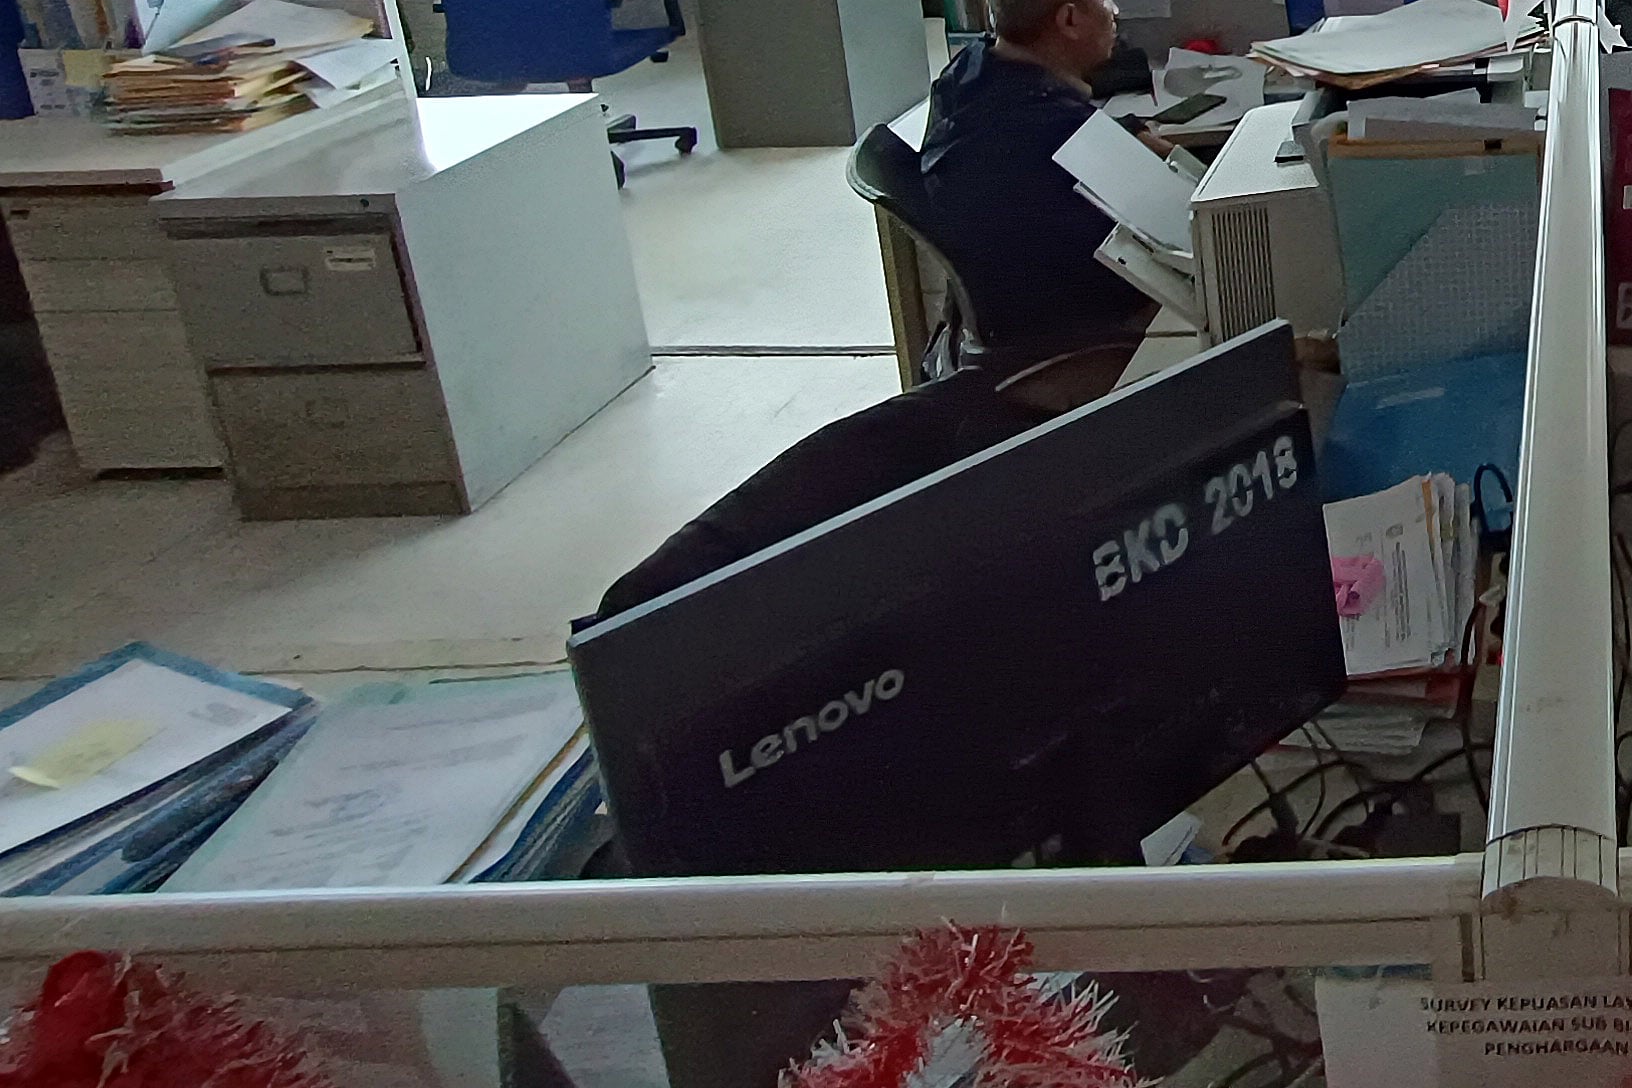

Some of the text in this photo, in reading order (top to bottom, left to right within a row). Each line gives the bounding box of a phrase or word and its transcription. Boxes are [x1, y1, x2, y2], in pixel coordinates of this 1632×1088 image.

[1092, 503, 1190, 602] BKD
[718, 668, 906, 789] Lenovo
[1420, 996, 1491, 1013] SURVEY
[1496, 995, 1598, 1012] KEPUASAN
[1426, 1017, 1565, 1034] KEPEGAWAIAN
[1570, 1015, 1608, 1031] SUB
[1483, 1038, 1630, 1056] PENGHARGAAN
